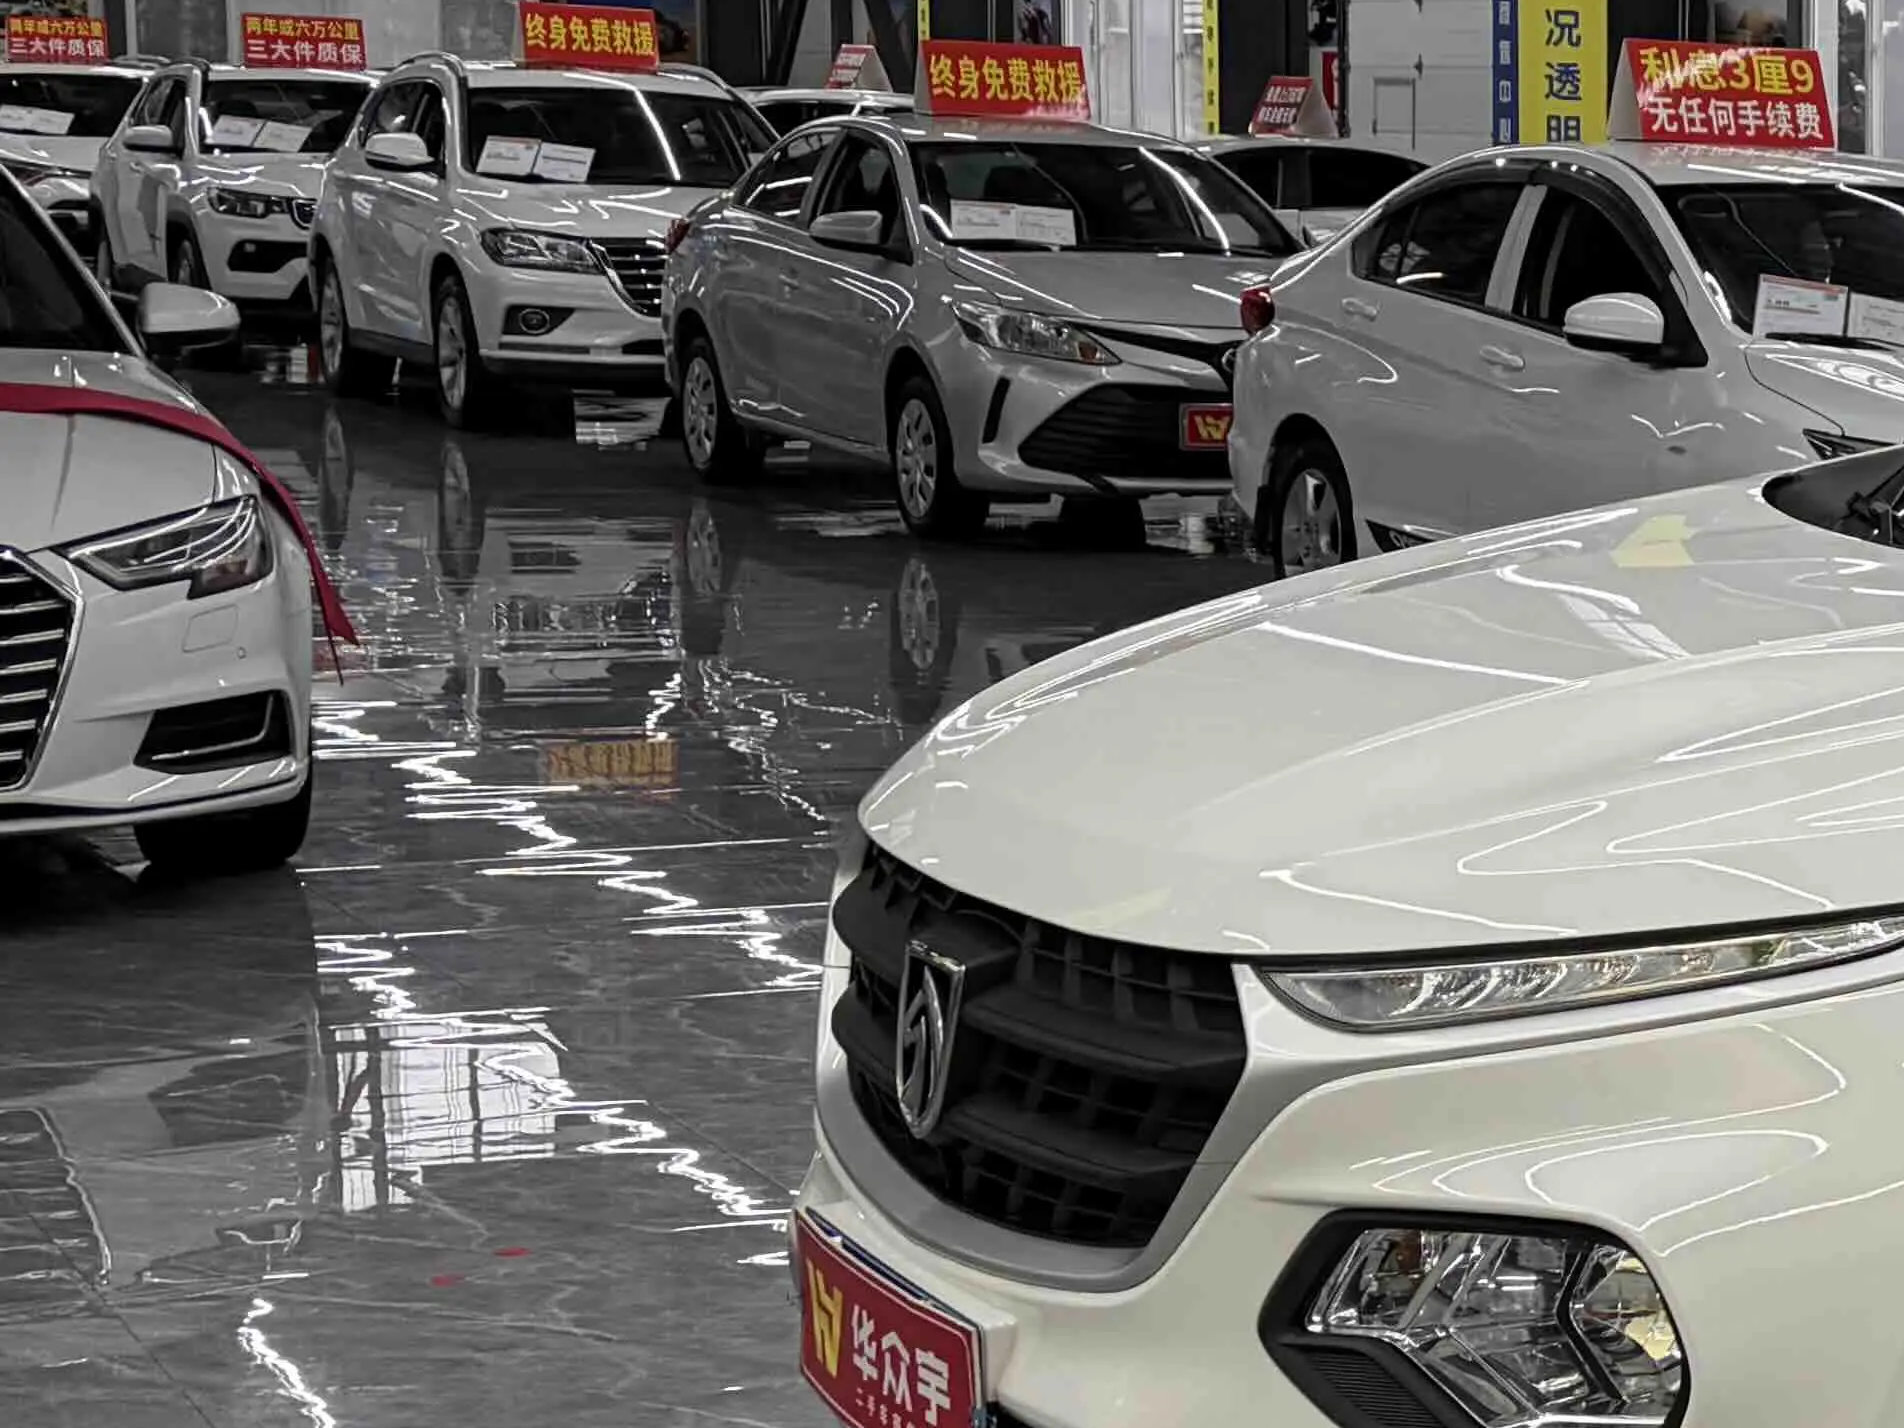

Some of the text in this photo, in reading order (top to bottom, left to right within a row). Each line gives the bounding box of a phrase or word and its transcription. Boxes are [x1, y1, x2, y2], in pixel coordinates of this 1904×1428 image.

[11, 37, 105, 57] 三大件质保
[247, 39, 363, 65] 三大件质保
[525, 12, 656, 57] 终身免费救援
[929, 52, 1085, 104] 终身免费救援
[1639, 46, 1814, 95] 利息3厘9
[1650, 95, 1824, 140] 无任何手续费
[850, 1304, 951, 1427] 华众宇
